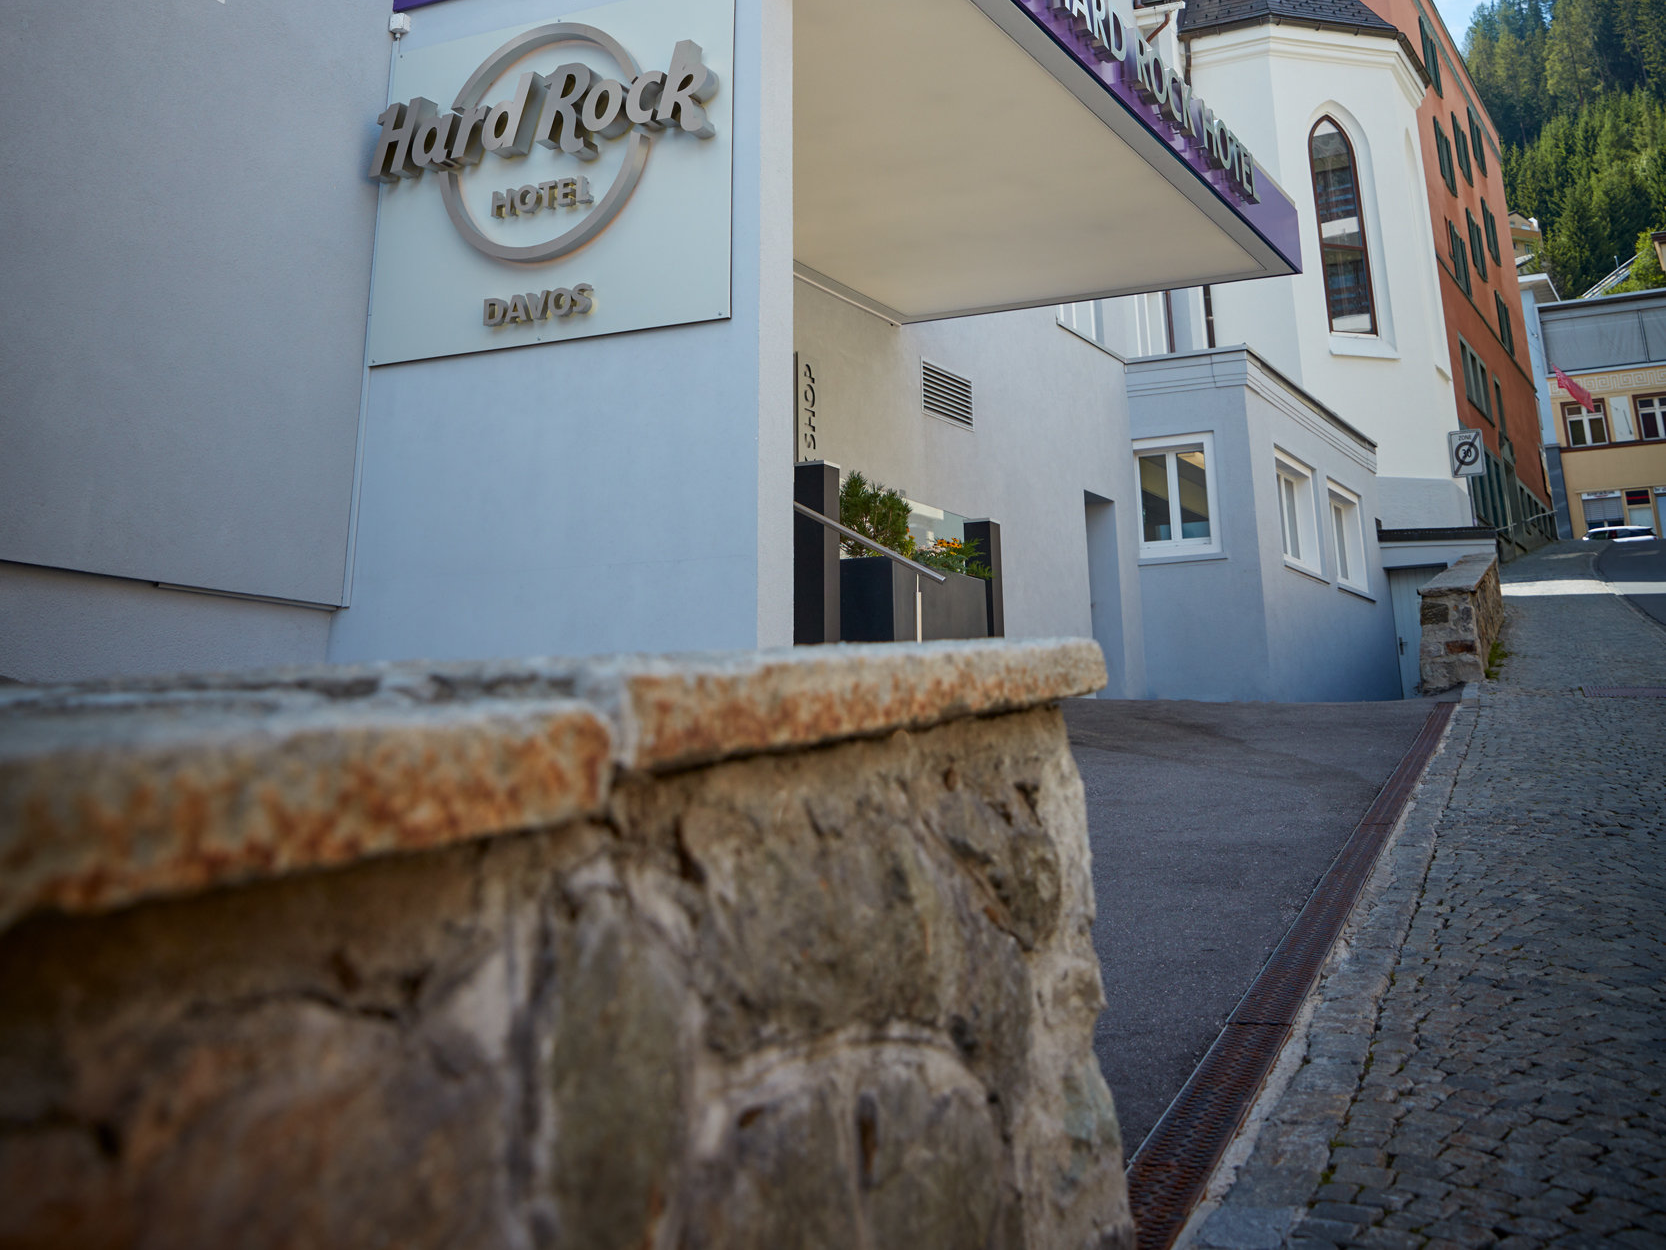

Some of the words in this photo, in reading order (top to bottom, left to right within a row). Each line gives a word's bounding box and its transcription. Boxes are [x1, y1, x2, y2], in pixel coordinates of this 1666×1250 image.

[368, 71, 545, 183] Hard
[536, 39, 719, 162] Rock
[1127, 27, 1197, 139] ROCK
[1197, 98, 1261, 205] HOTEL
[490, 176, 594, 219] HOTEL
[483, 283, 594, 329] DAVOS
[804, 363, 816, 450] SHOP
[1462, 448, 1472, 459] 30
